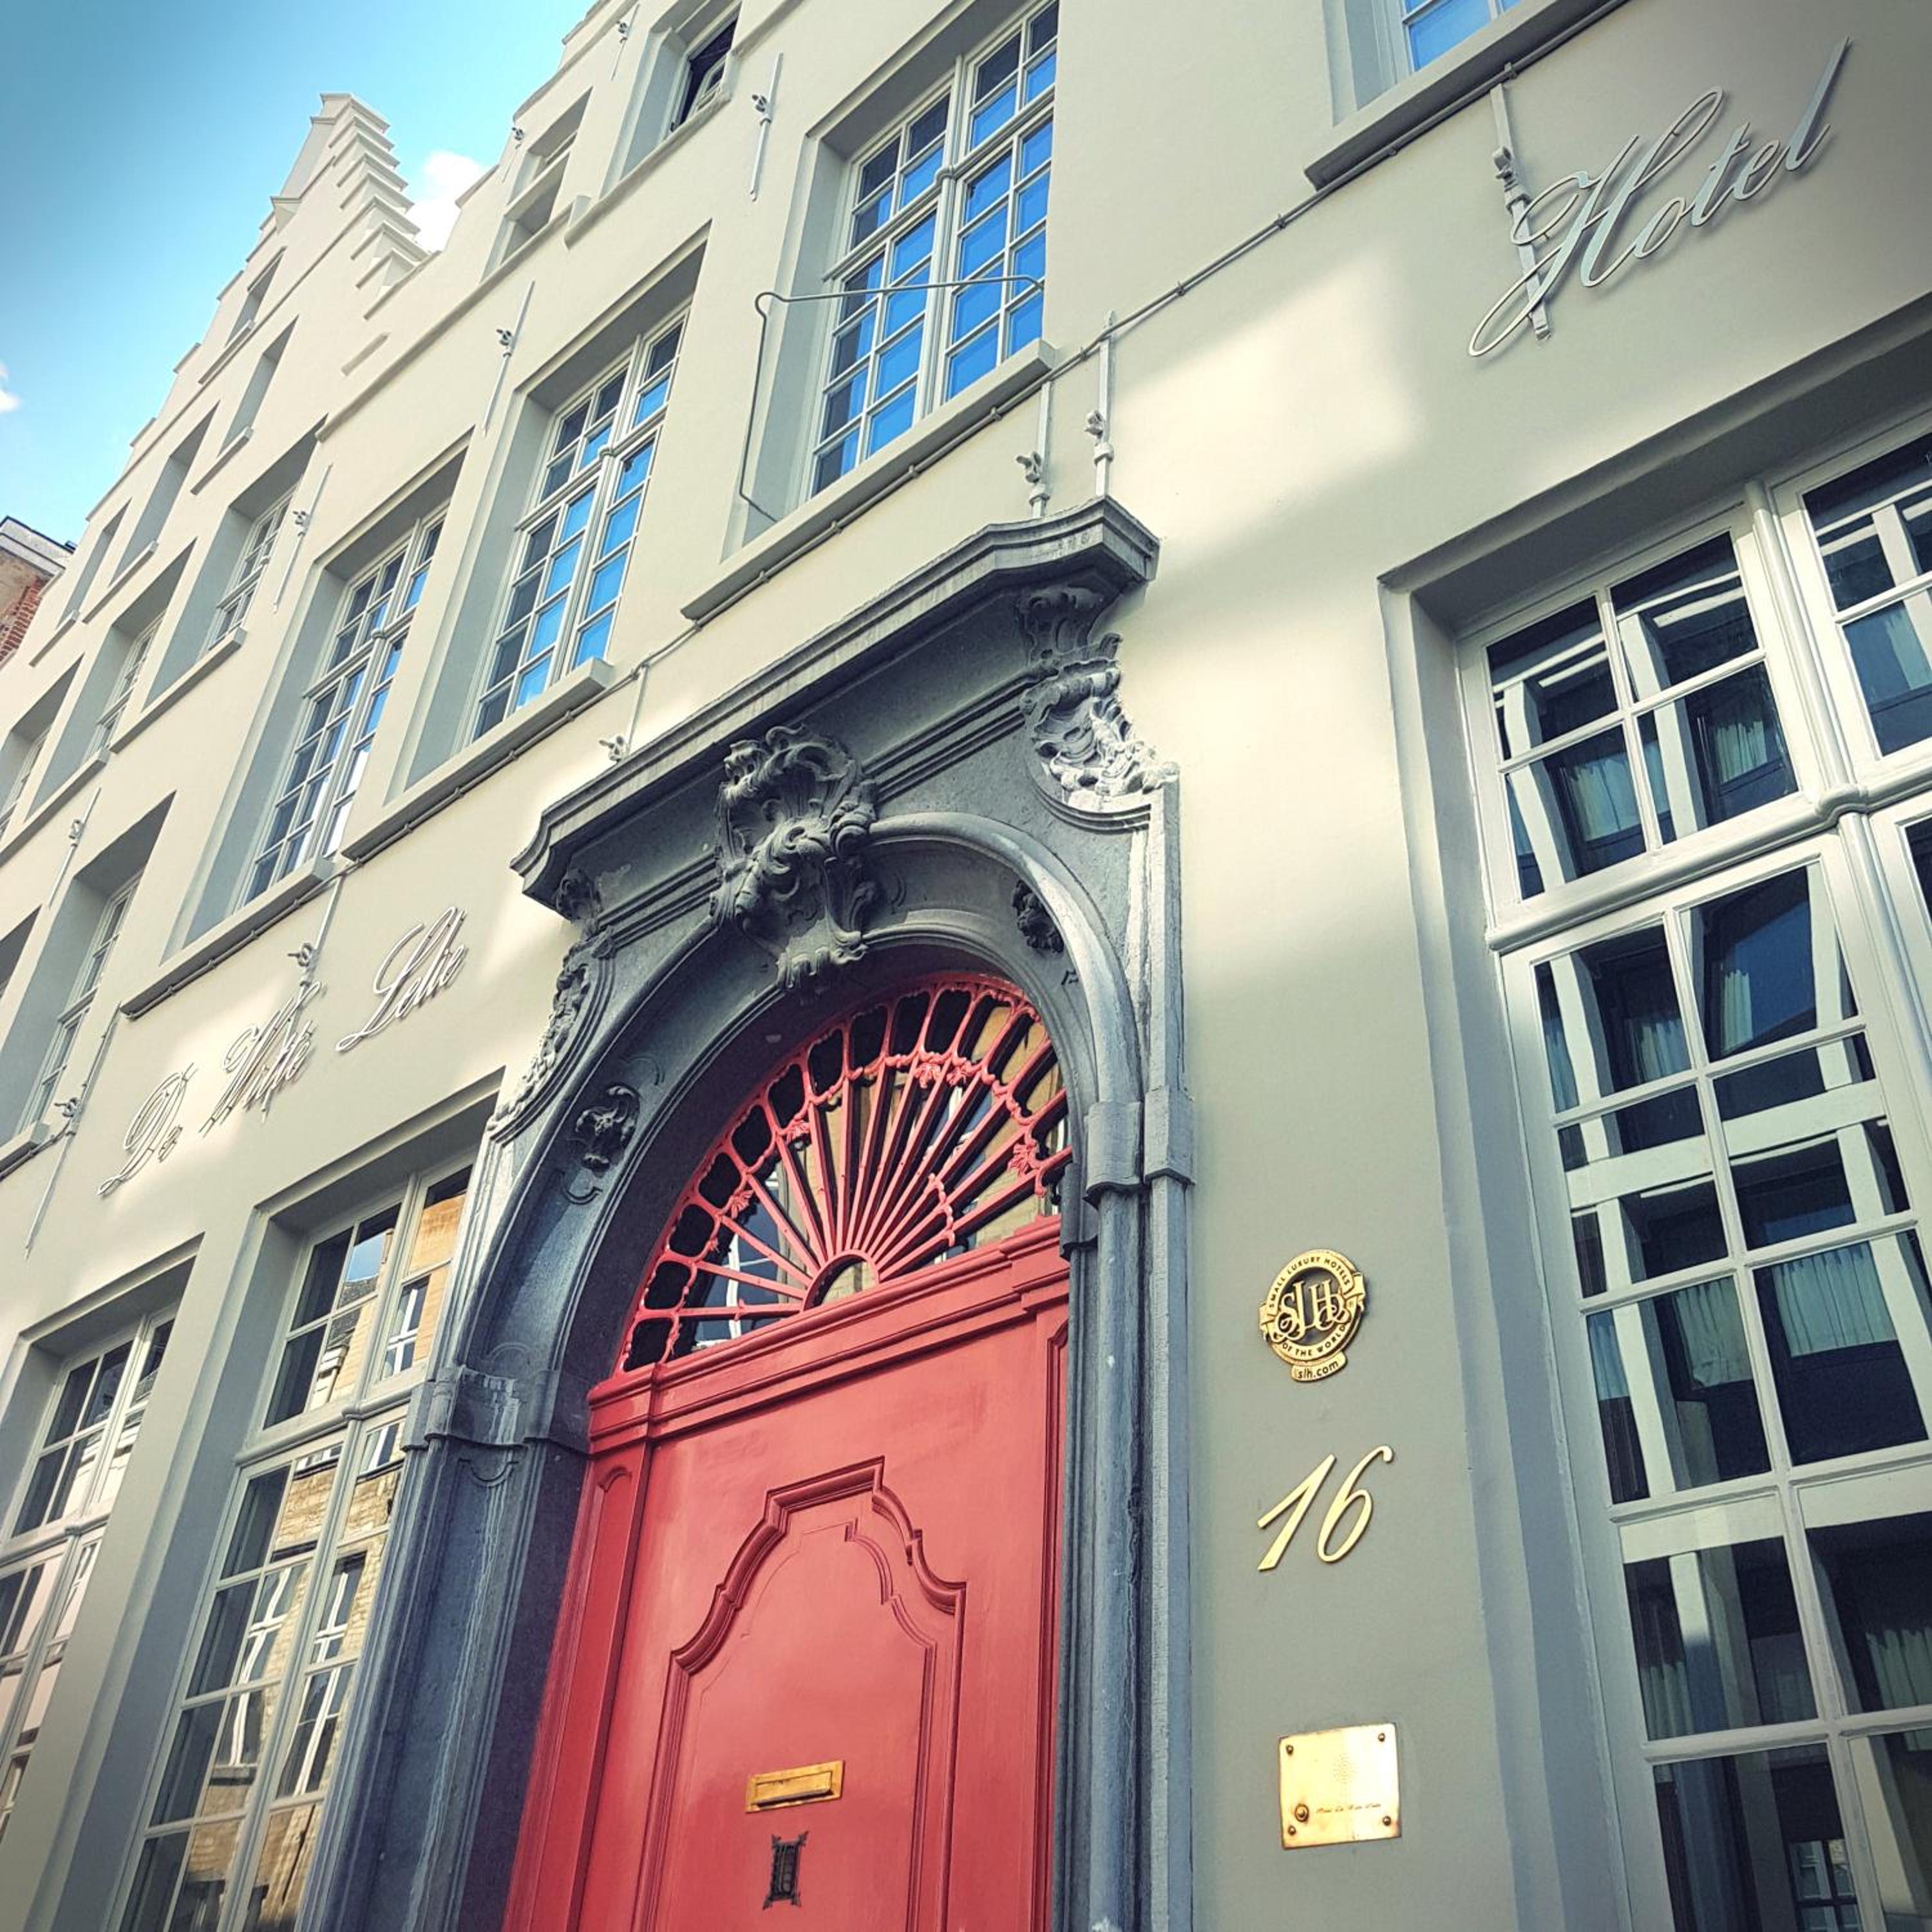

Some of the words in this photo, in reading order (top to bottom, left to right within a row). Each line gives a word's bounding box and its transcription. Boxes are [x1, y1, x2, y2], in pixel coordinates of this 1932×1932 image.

[1468, 35, 1853, 357] Hotel
[97, 1062, 198, 1197] De
[1269, 1276, 1286, 1309] SMALL
[1287, 1256, 1321, 1275] LUXURY
[1323, 1258, 1350, 1286] HOTELS
[1282, 1342, 1293, 1353] OF
[1295, 1348, 1312, 1356] THE
[1316, 1324, 1346, 1353] WORLD
[1298, 1360, 1339, 1379] slh.com
[1257, 1445, 1394, 1571] 16
